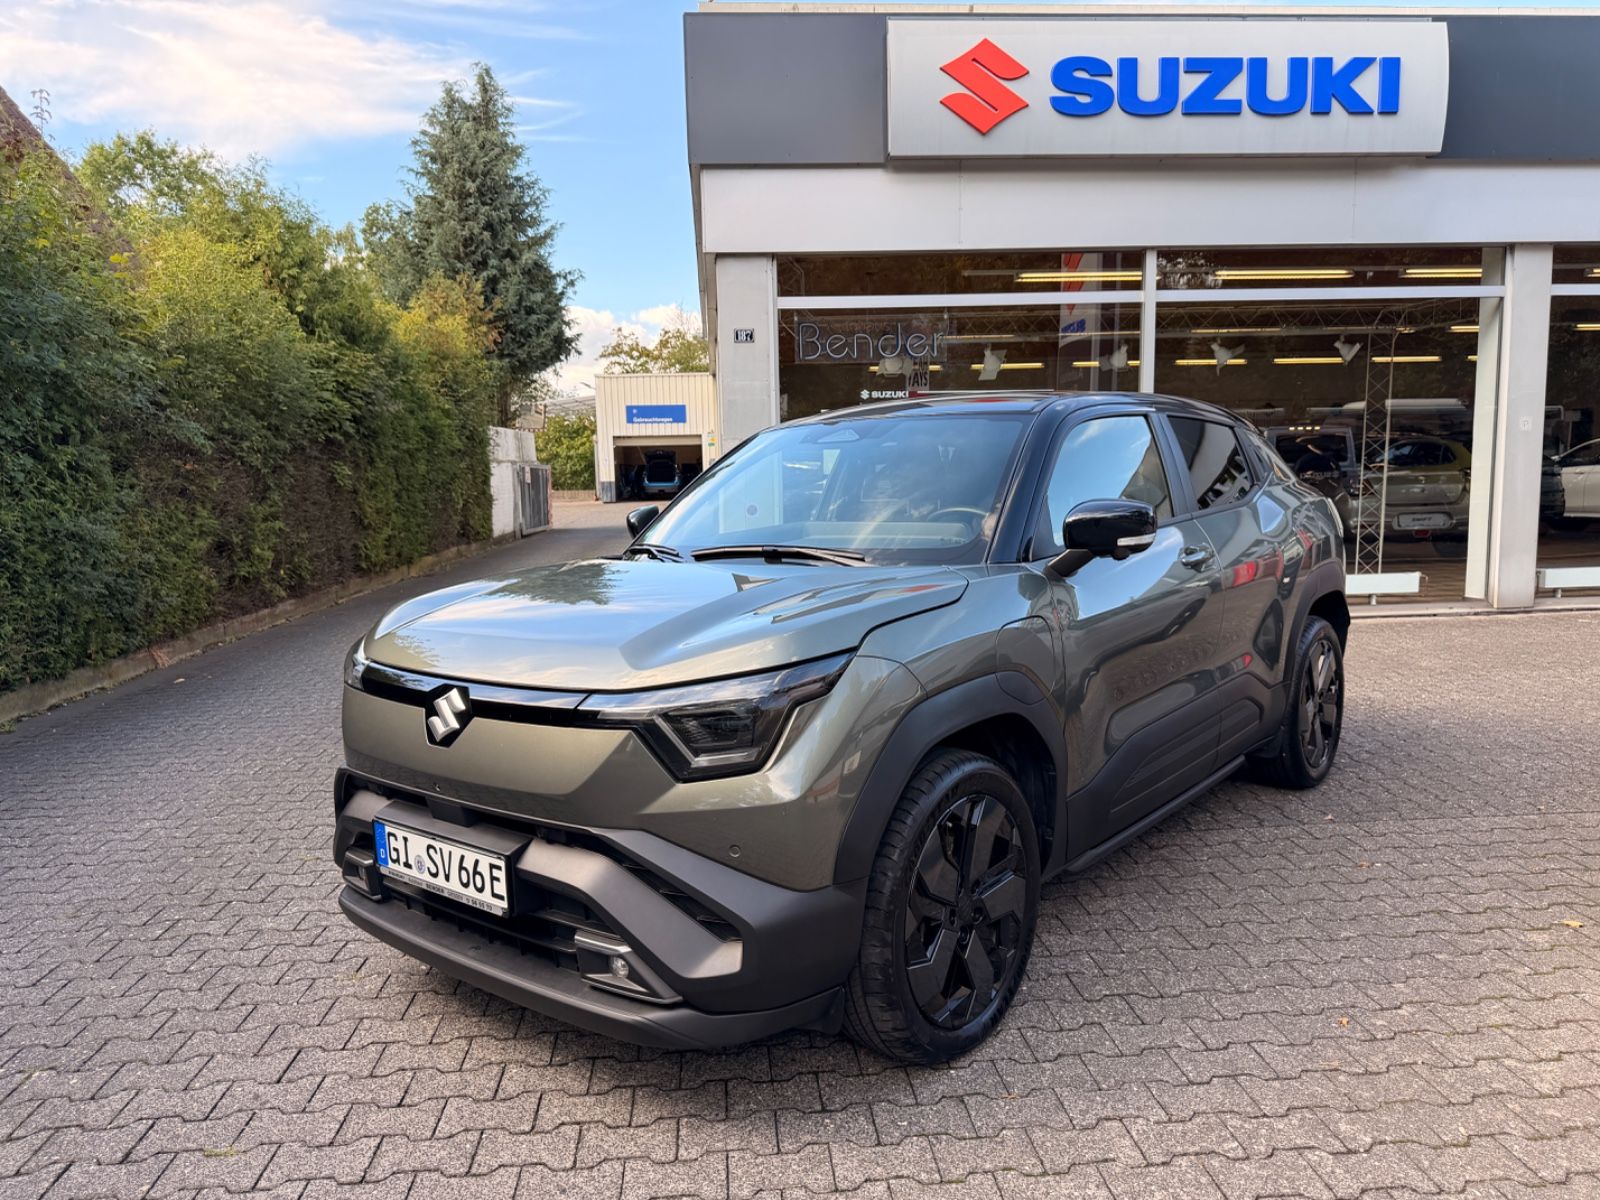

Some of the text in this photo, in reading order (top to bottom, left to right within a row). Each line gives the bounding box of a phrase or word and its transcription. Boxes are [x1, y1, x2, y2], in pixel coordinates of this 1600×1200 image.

[1050, 56, 1401, 117] SUZUKI
[737, 330, 752, 341] 187
[799, 322, 944, 360] Bender
[871, 390, 909, 398] SUZUKI
[387, 831, 413, 870] GI
